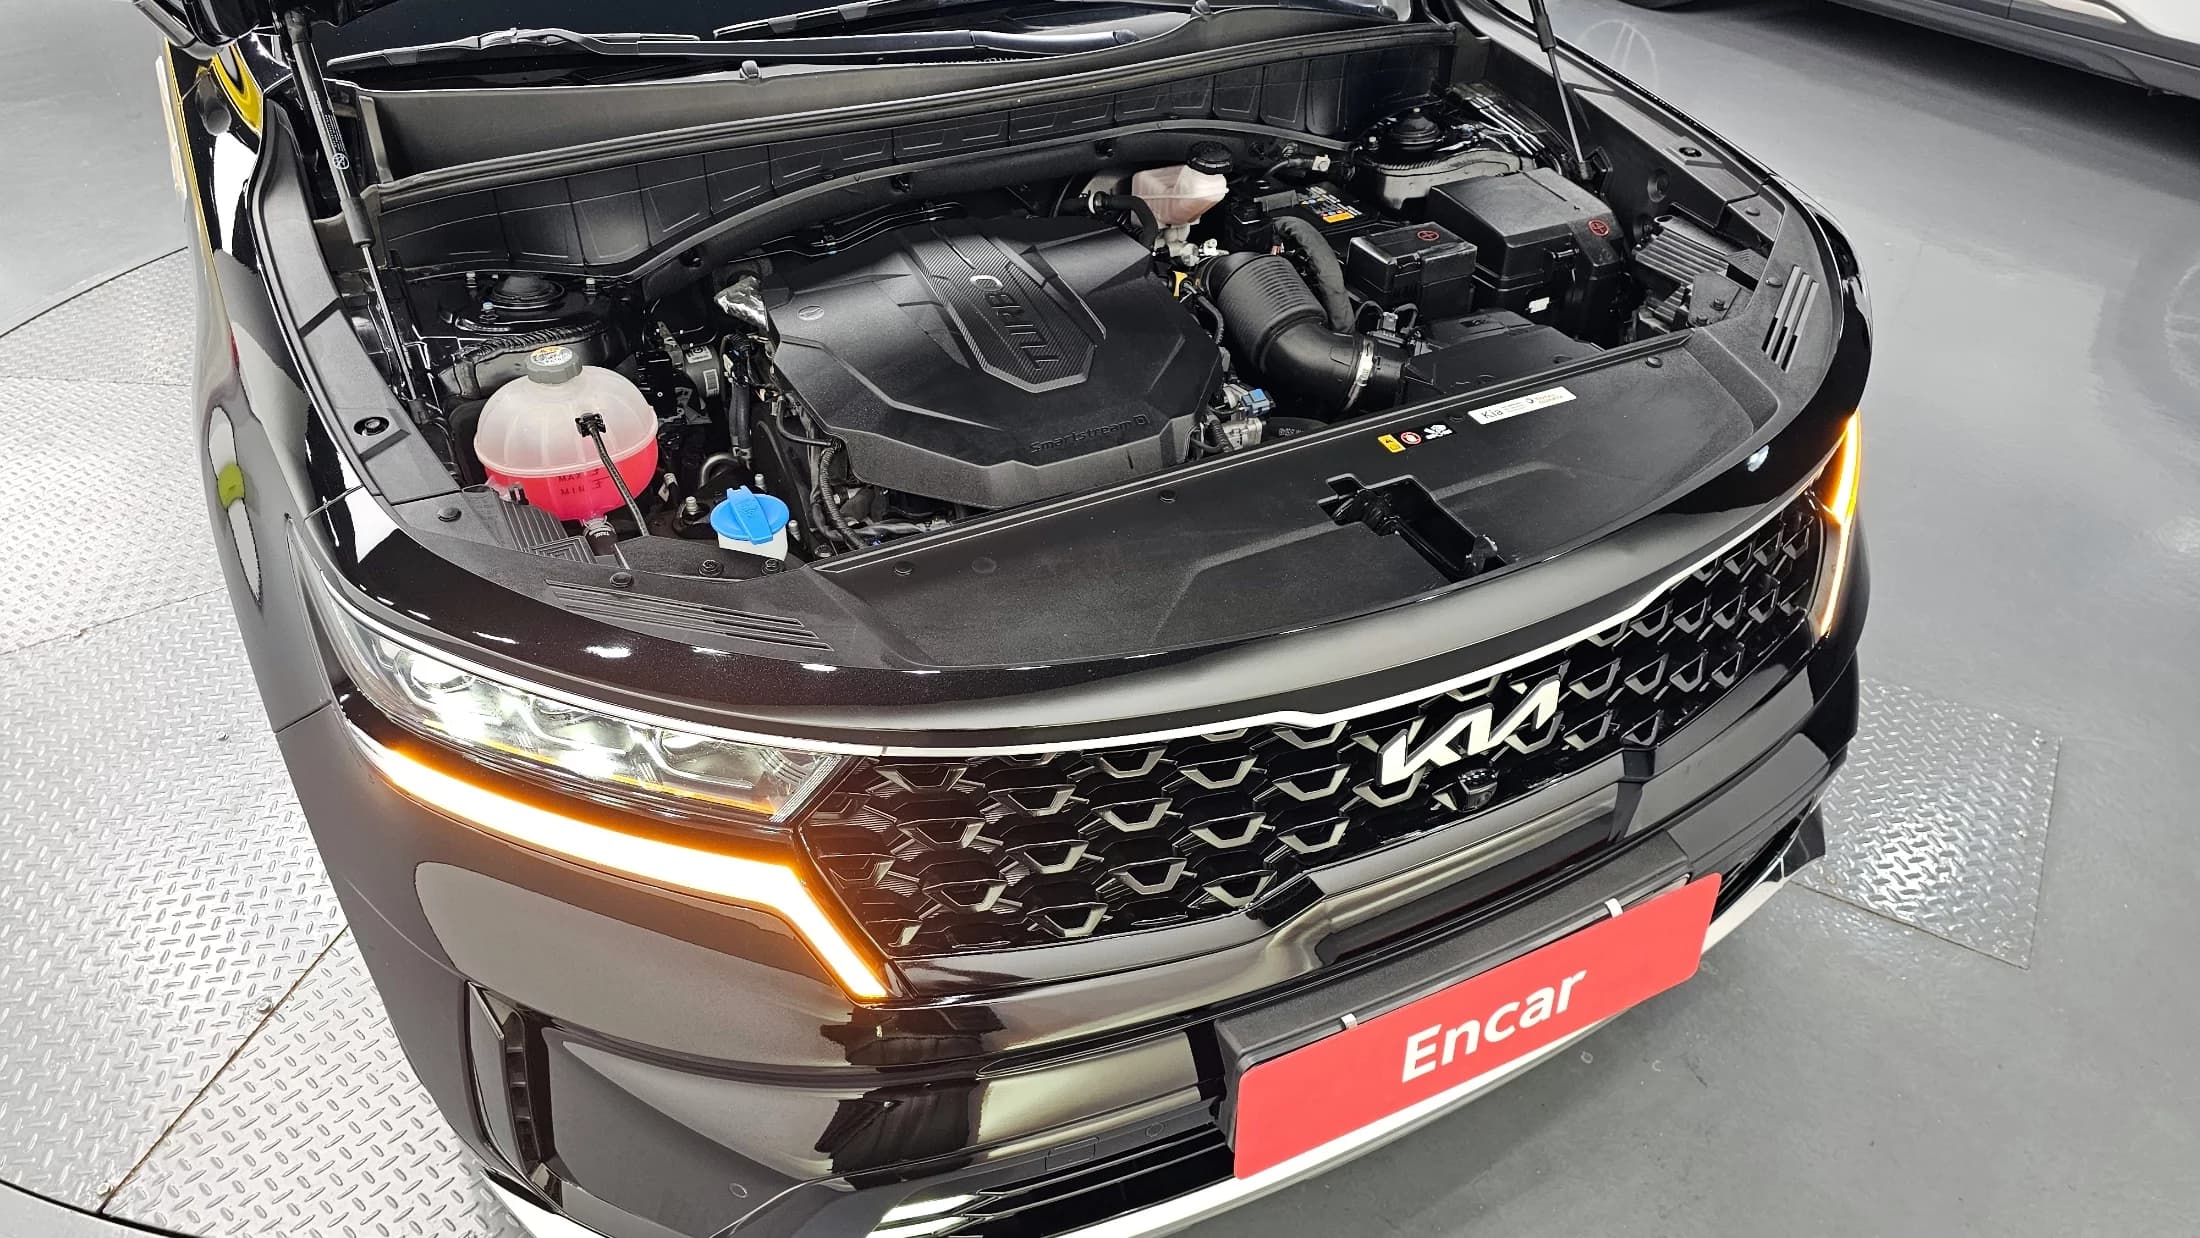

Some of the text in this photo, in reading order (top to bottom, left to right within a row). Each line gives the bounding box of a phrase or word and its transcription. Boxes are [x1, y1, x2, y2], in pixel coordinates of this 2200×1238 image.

[1481, 408, 1504, 419] Kia
[1030, 420, 1132, 453] Smartstream
[1401, 968, 1588, 1084] Encar
